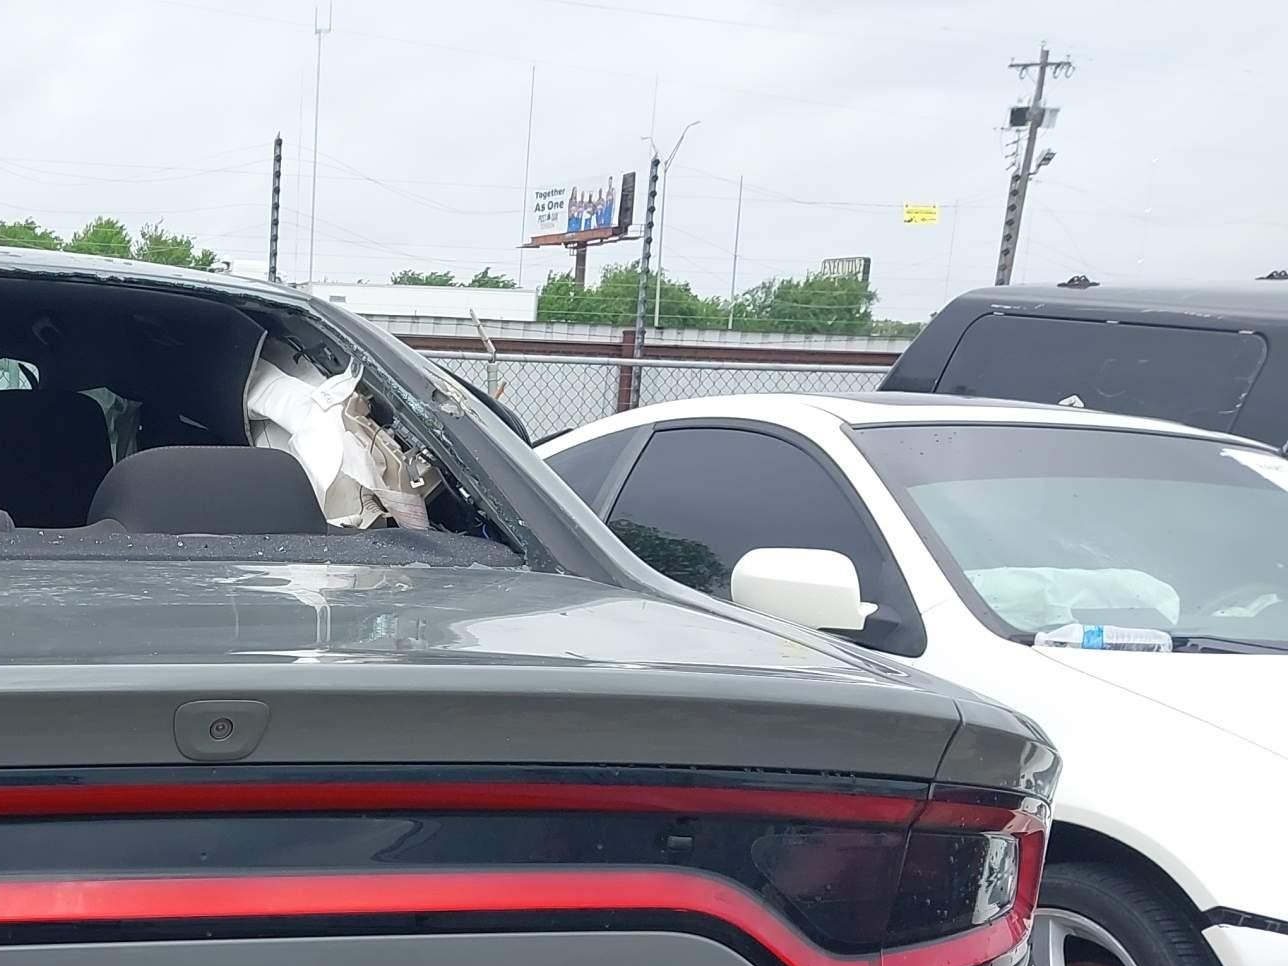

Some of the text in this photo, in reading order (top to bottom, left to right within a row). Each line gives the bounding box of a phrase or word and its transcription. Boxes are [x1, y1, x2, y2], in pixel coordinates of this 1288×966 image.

[535, 188, 566, 200] Together
[534, 200, 564, 213] As One
